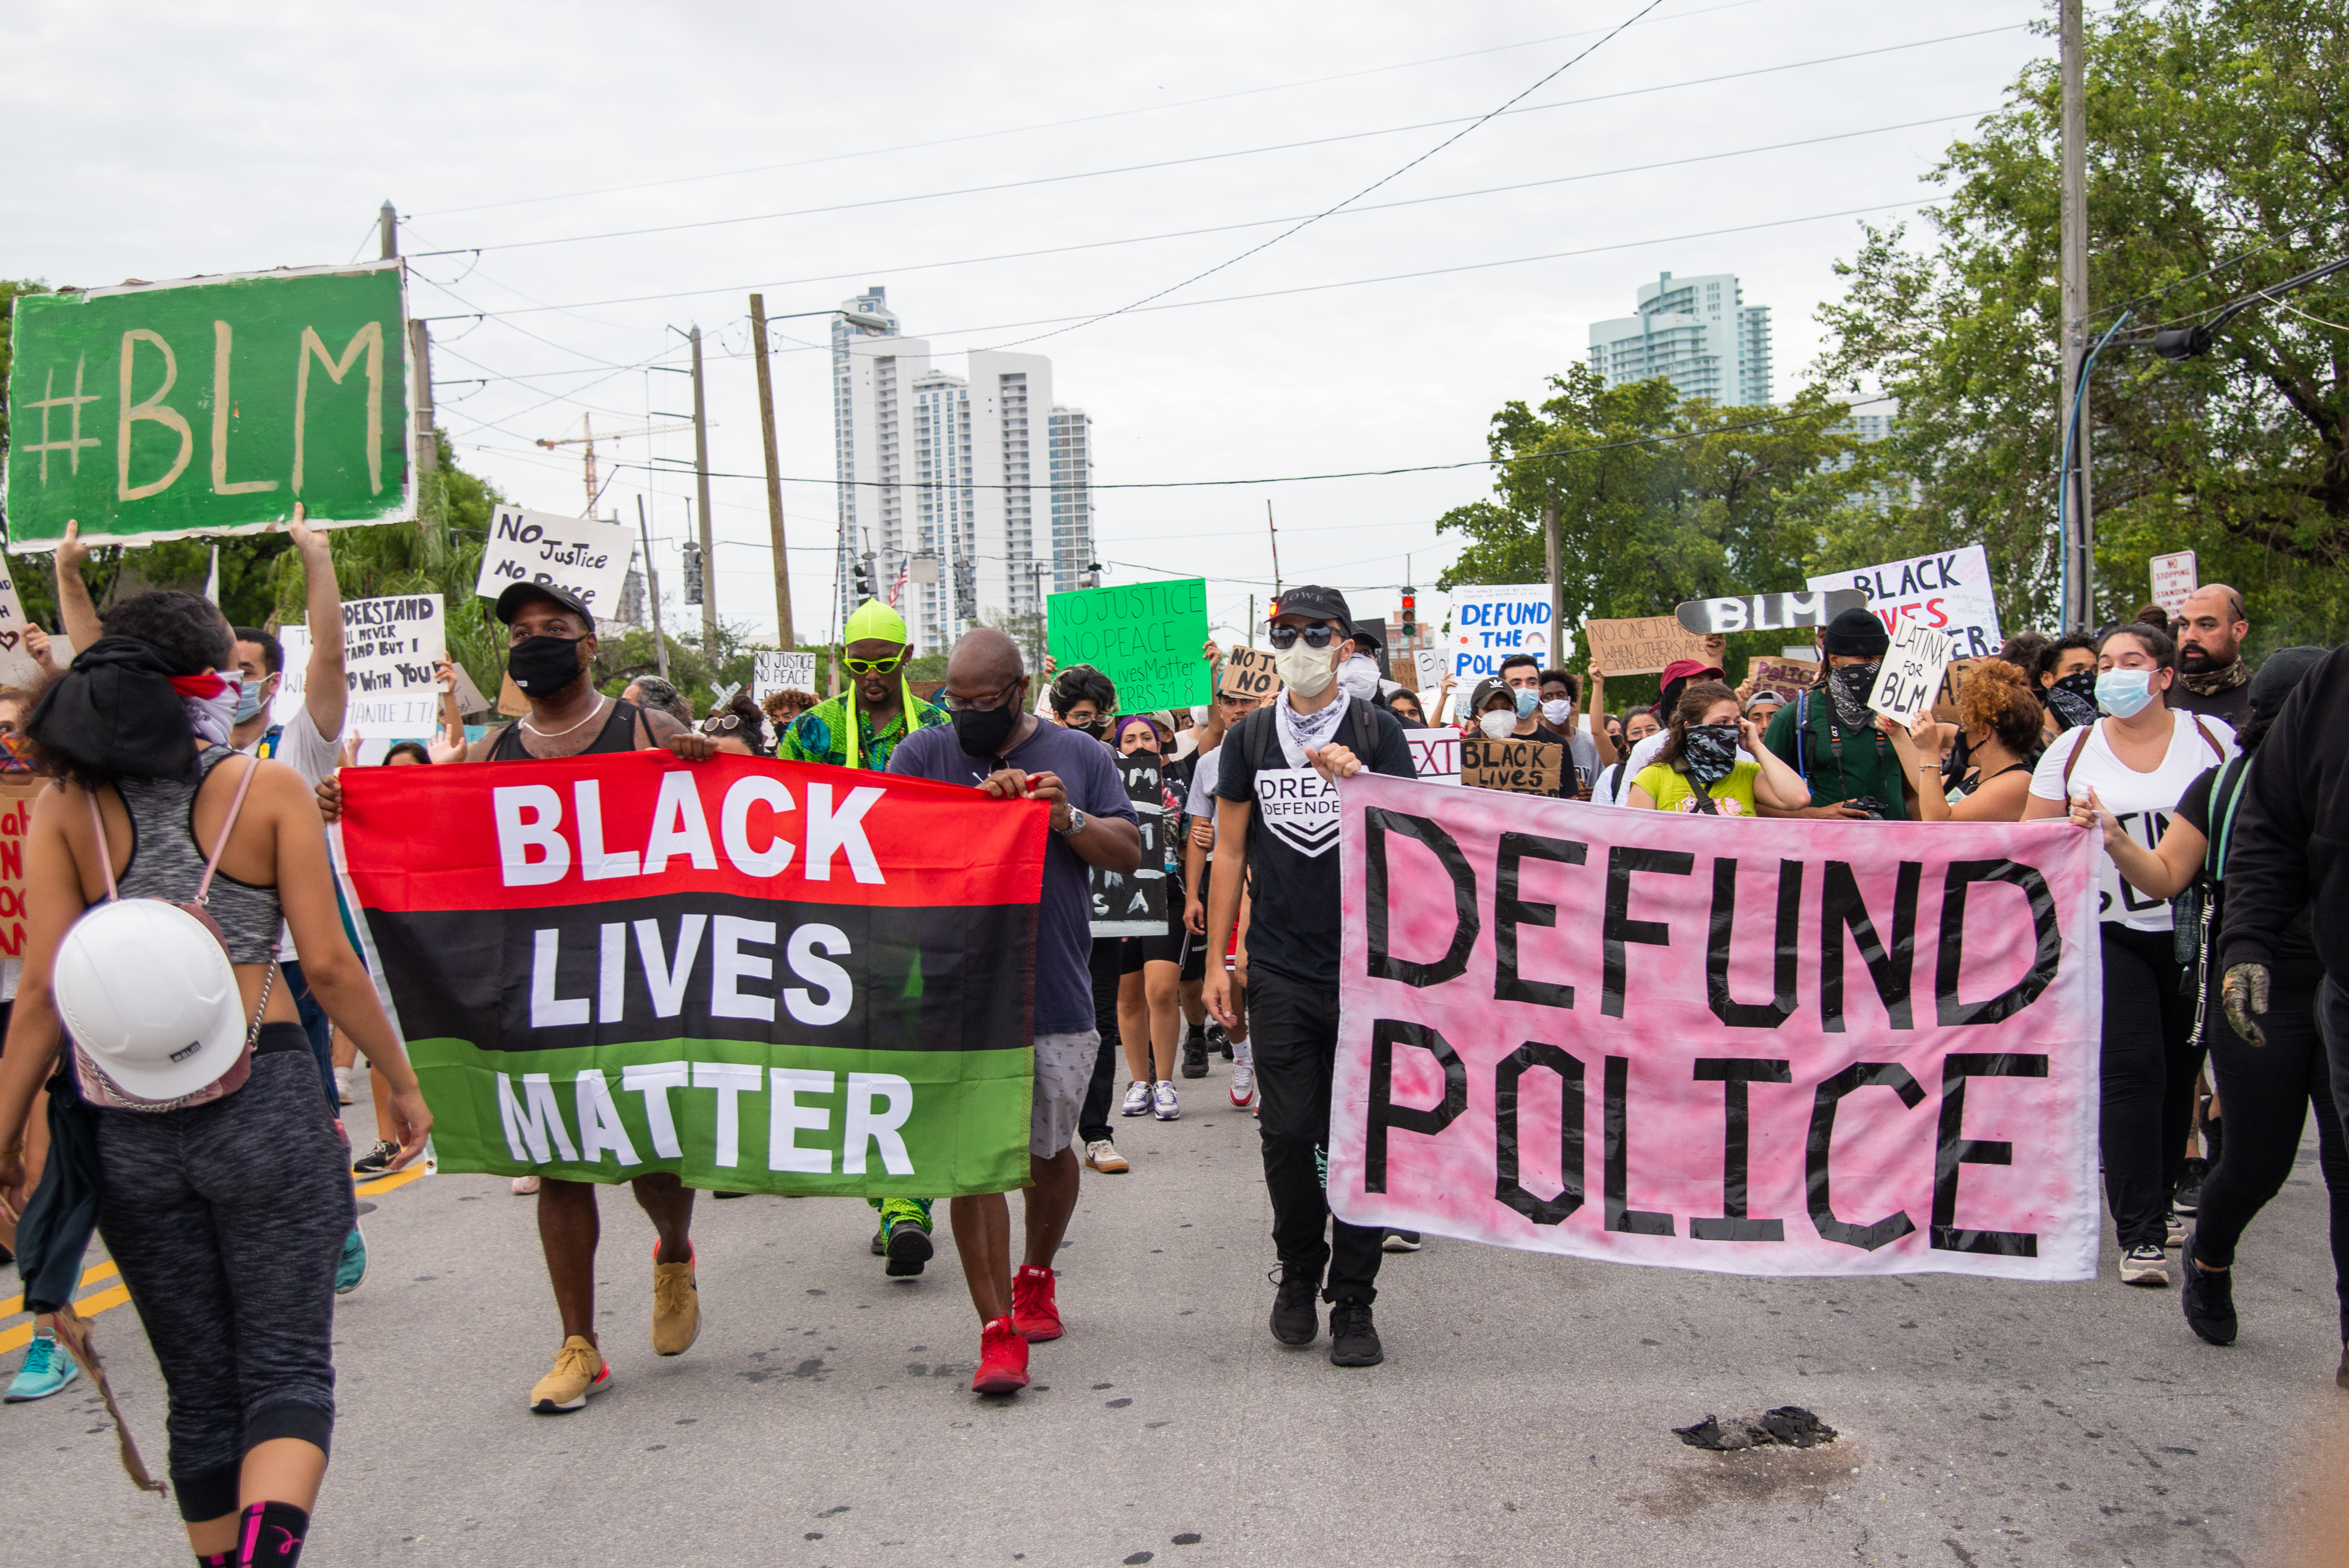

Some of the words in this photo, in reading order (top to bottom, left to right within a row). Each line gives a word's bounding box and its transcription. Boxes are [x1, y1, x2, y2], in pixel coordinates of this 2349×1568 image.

[22, 320, 383, 501] #BLM
[497, 514, 544, 544] NO
[534, 573, 596, 605] Pce
[1853, 555, 1962, 600] BLACK
[1053, 596, 1089, 629] NO
[1095, 584, 1203, 621] JUSTICE
[1462, 602, 1551, 626] DEFUND
[1705, 591, 1826, 633] BLM
[359, 625, 396, 641] NEVER
[1063, 631, 1100, 661] NO
[1103, 621, 1175, 658] PEACE
[1480, 629, 1522, 648] THE
[1591, 623, 1616, 642] NO
[1618, 620, 1646, 640] ONE
[1895, 619, 1951, 669] LATINX
[379, 641, 404, 656] BUT
[755, 652, 770, 668] NO
[774, 653, 815, 669] JUSTICE
[1230, 648, 1255, 667] NO
[1601, 644, 1633, 659] WHEN
[1634, 641, 1682, 657] OTHERS
[1684, 639, 1706, 652] ARE
[755, 669, 770, 682] NO
[774, 670, 810, 684] PEACE
[1456, 652, 1545, 677] POLE
[1902, 660, 1923, 678] FOR
[1237, 670, 1271, 692] NO
[1880, 672, 1928, 714] BLM
[1117, 684, 1156, 711] ERBS
[1461, 742, 1547, 769] BLACK
[492, 770, 887, 887] BLACK
[1365, 805, 2062, 1033] DEFUND
[2200, 903, 2215, 925] PINK
[2200, 942, 2209, 964] PINK
[530, 913, 854, 1028] LIVES
[2197, 981, 2208, 1003] PINK
[2191, 1021, 2203, 1043] PINK
[496, 1060, 916, 1175] MATTER
[1364, 1018, 2049, 1258] POLICE
